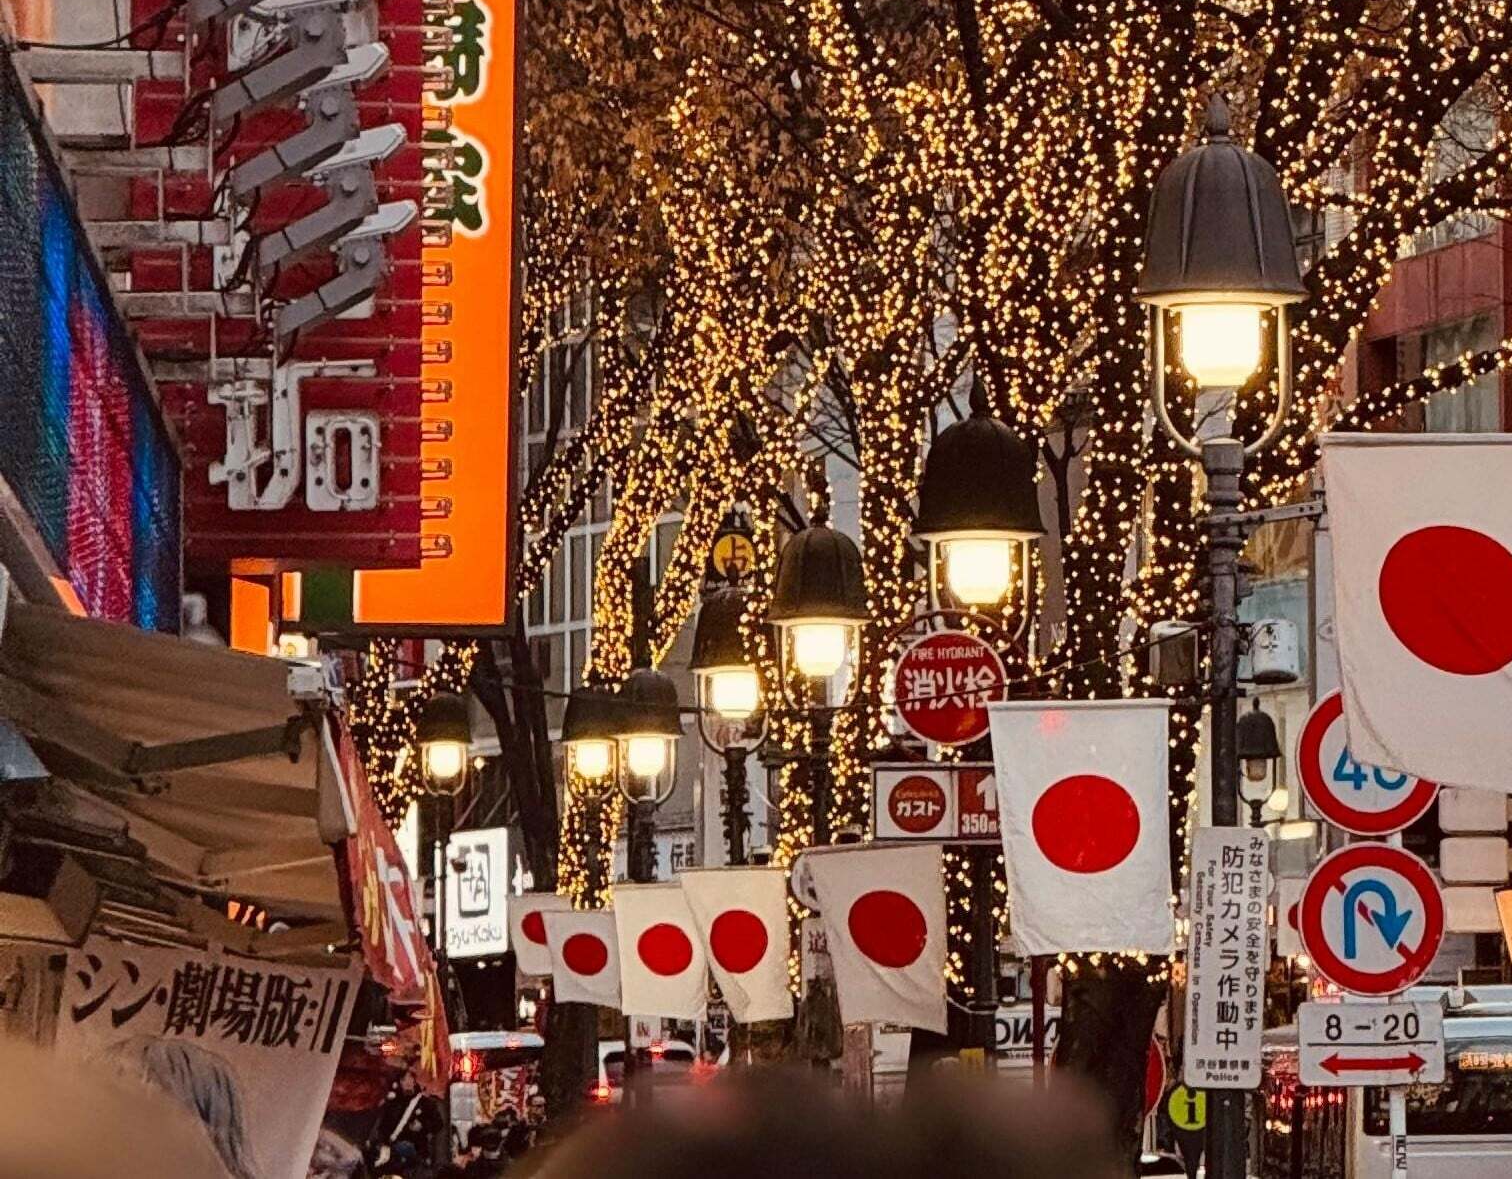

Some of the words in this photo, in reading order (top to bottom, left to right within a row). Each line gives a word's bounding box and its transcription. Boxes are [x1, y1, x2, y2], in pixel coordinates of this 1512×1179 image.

[911, 648, 935, 662] FIRE
[937, 645, 985, 660] HYDRANT
[903, 666, 997, 711] 消火栓
[896, 801, 941, 818] ガスト
[1207, 859, 1217, 876] For
[1206, 883, 1216, 908] Your
[1245, 836, 1265, 1031] みなさまの安全を守ります
[1215, 845, 1244, 1052] 防犯カメラ作動中
[1206, 1072, 1240, 1082] Police
